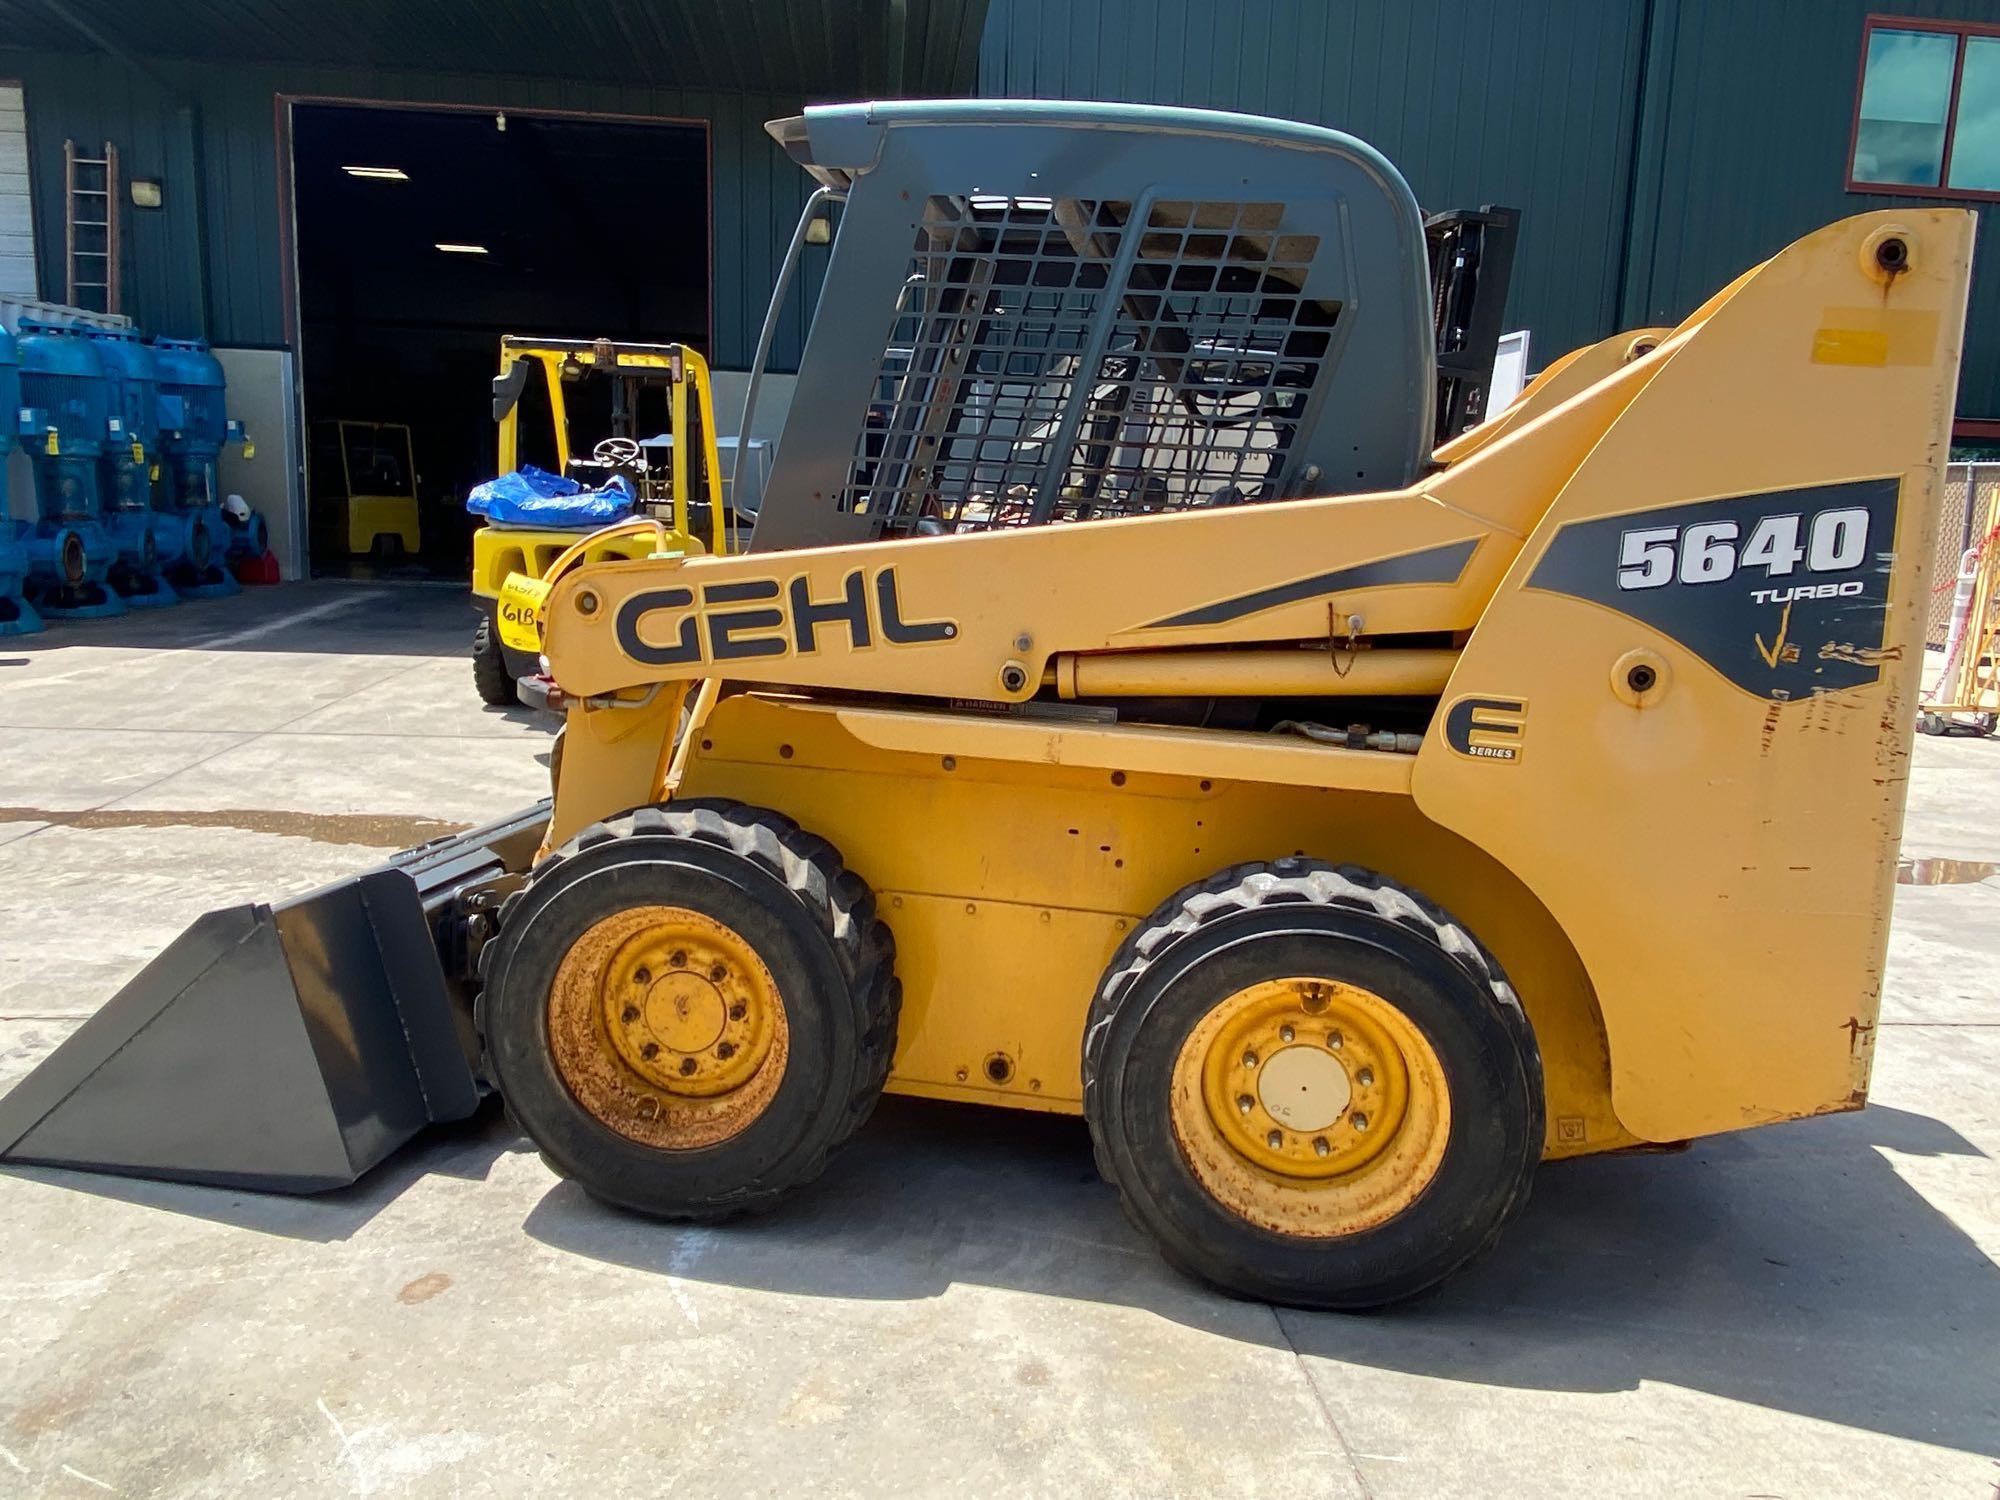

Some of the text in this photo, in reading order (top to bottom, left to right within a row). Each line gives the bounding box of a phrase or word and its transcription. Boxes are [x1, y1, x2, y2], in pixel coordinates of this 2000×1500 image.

[1617, 506, 1870, 591] 5640
[615, 566, 959, 666] GEHL
[1751, 581, 1864, 604] TURBO
[1469, 746, 1513, 758] SERIES
